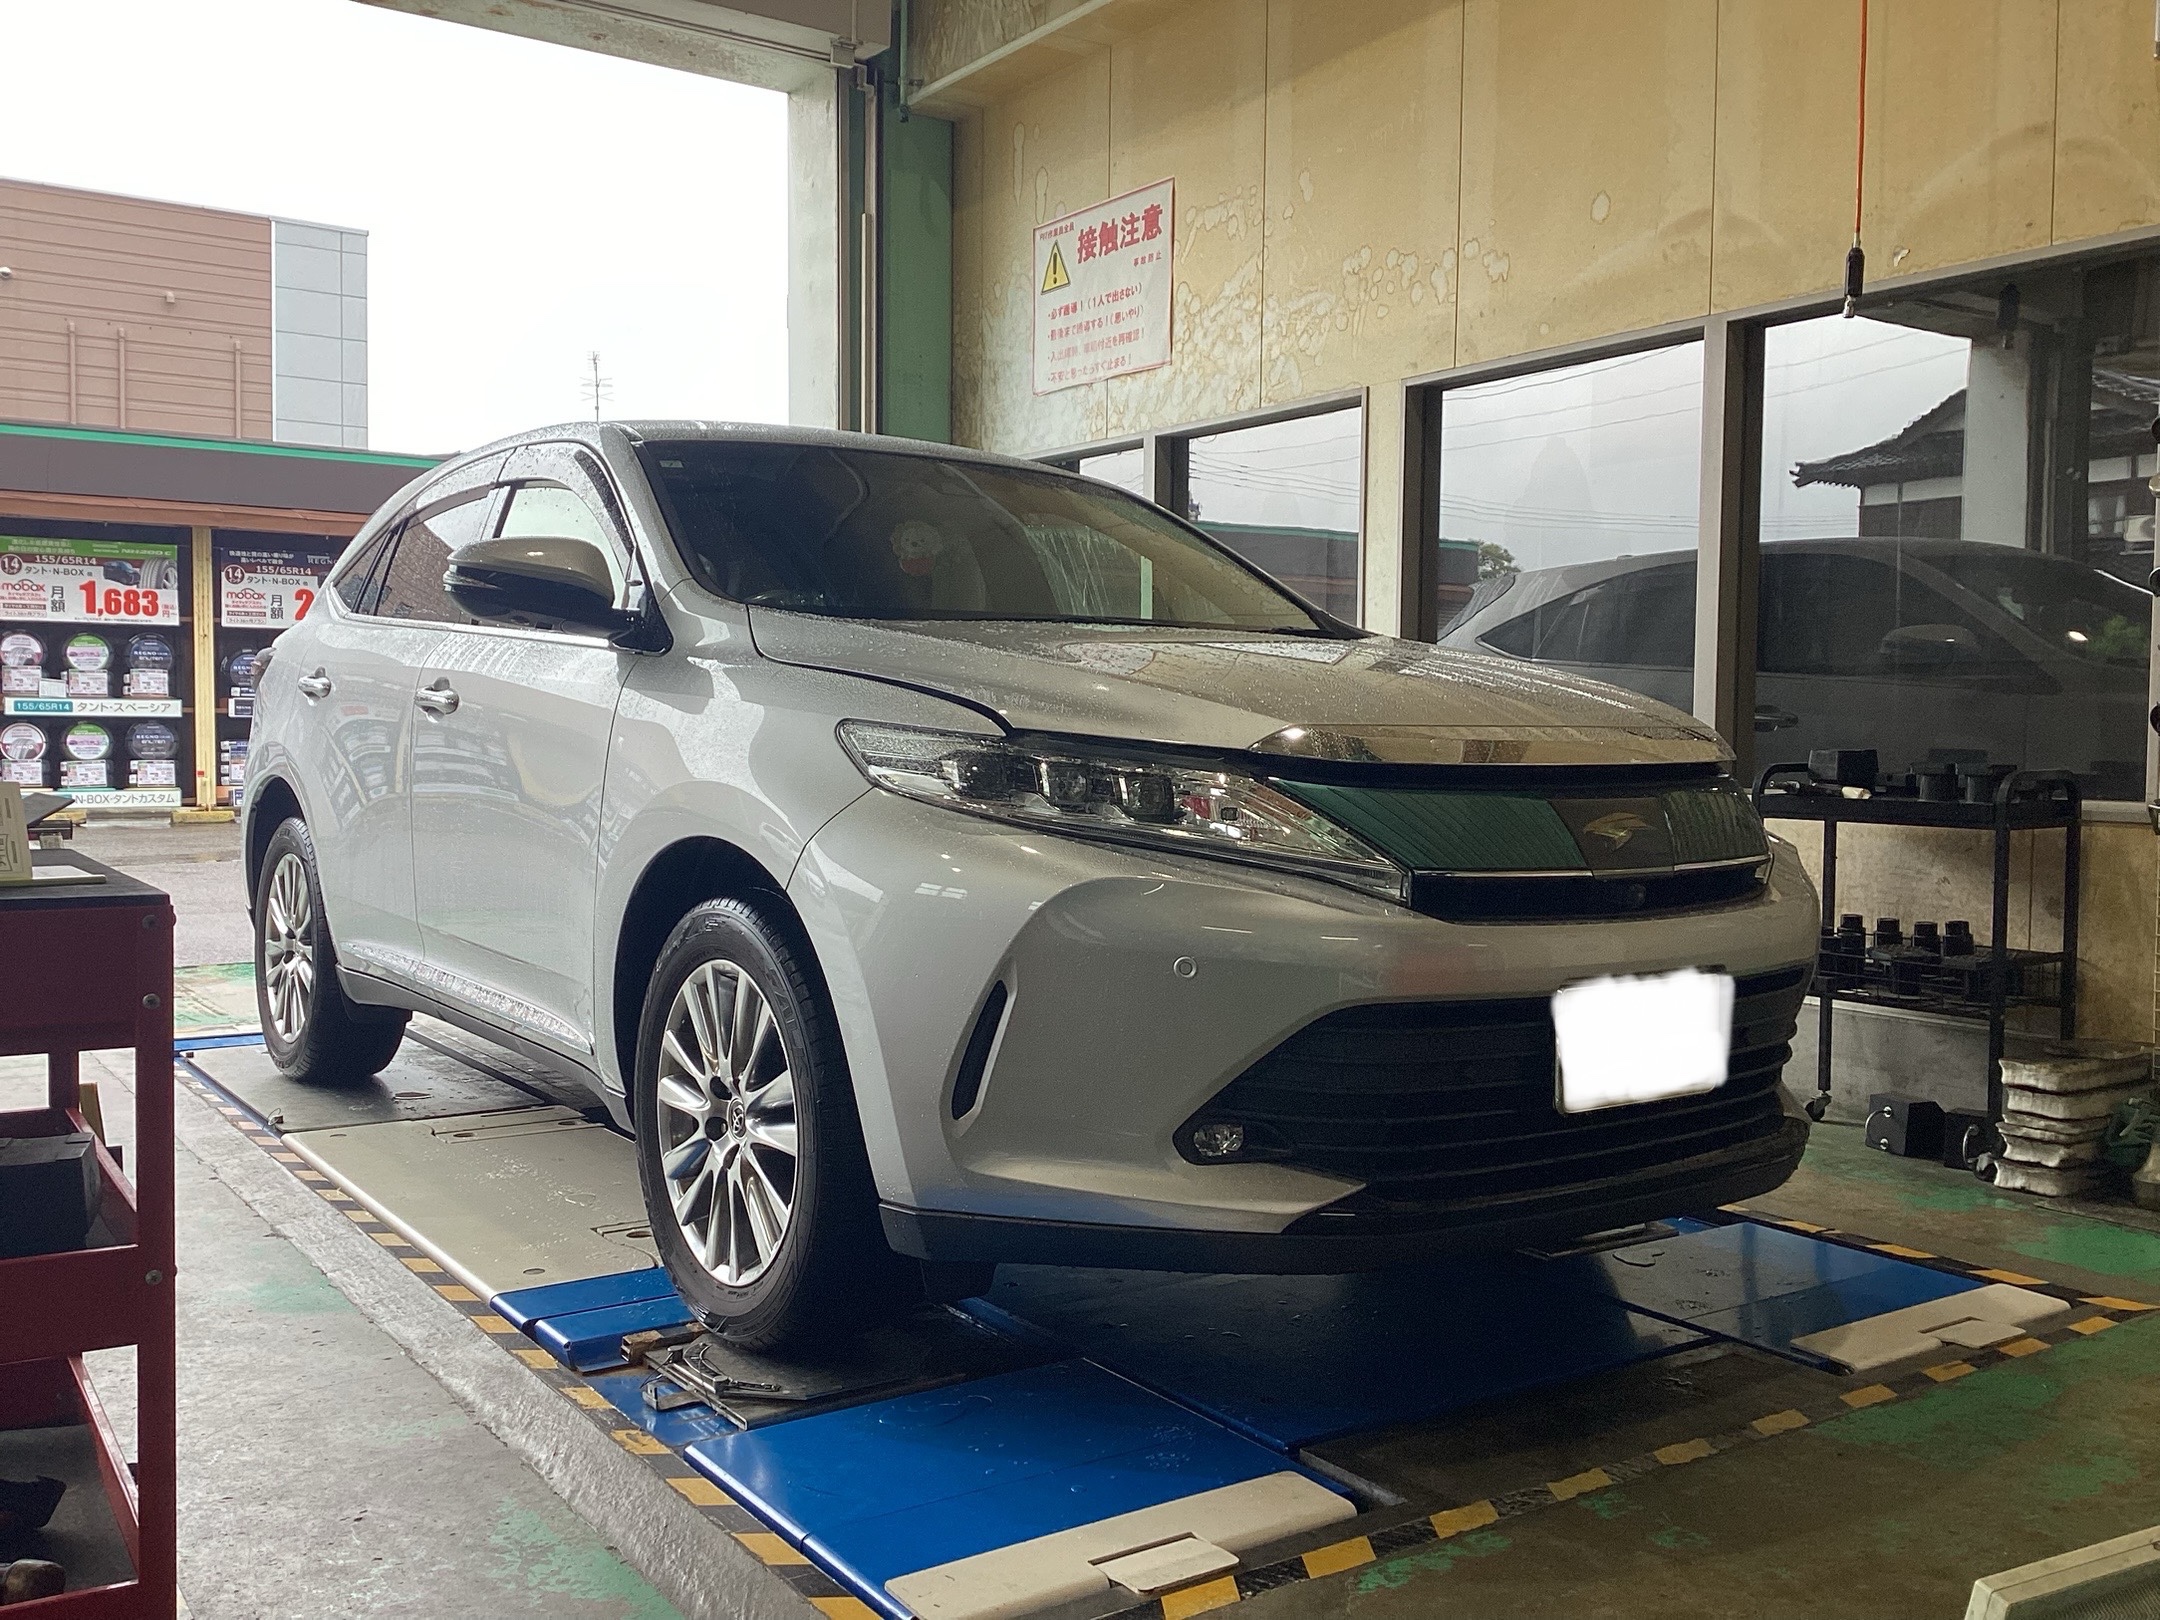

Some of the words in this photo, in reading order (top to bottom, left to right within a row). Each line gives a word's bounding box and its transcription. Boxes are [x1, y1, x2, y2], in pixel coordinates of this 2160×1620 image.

[1077, 203, 1163, 265] 接触注意
[3, 557, 20, 568] 14
[35, 555, 97, 566] 155/65R14
[25, 566, 84, 577] タント・N-BOX
[227, 568, 242, 578] 14
[256, 566, 311, 575] 155/65R14
[2, 579, 46, 592] mobox
[246, 576, 301, 586] タント・N-BOX
[51, 586, 65, 612] 月額
[79, 580, 159, 616] 1,683
[226, 588, 266, 600] mobox
[270, 594, 284, 620] 月額
[295, 588, 314, 621] 2
[16, 702, 70, 711] 155/65R14
[77, 703, 170, 712] タント・スペーシア
[75, 793, 175, 804] N-BOX・タントカスタム
